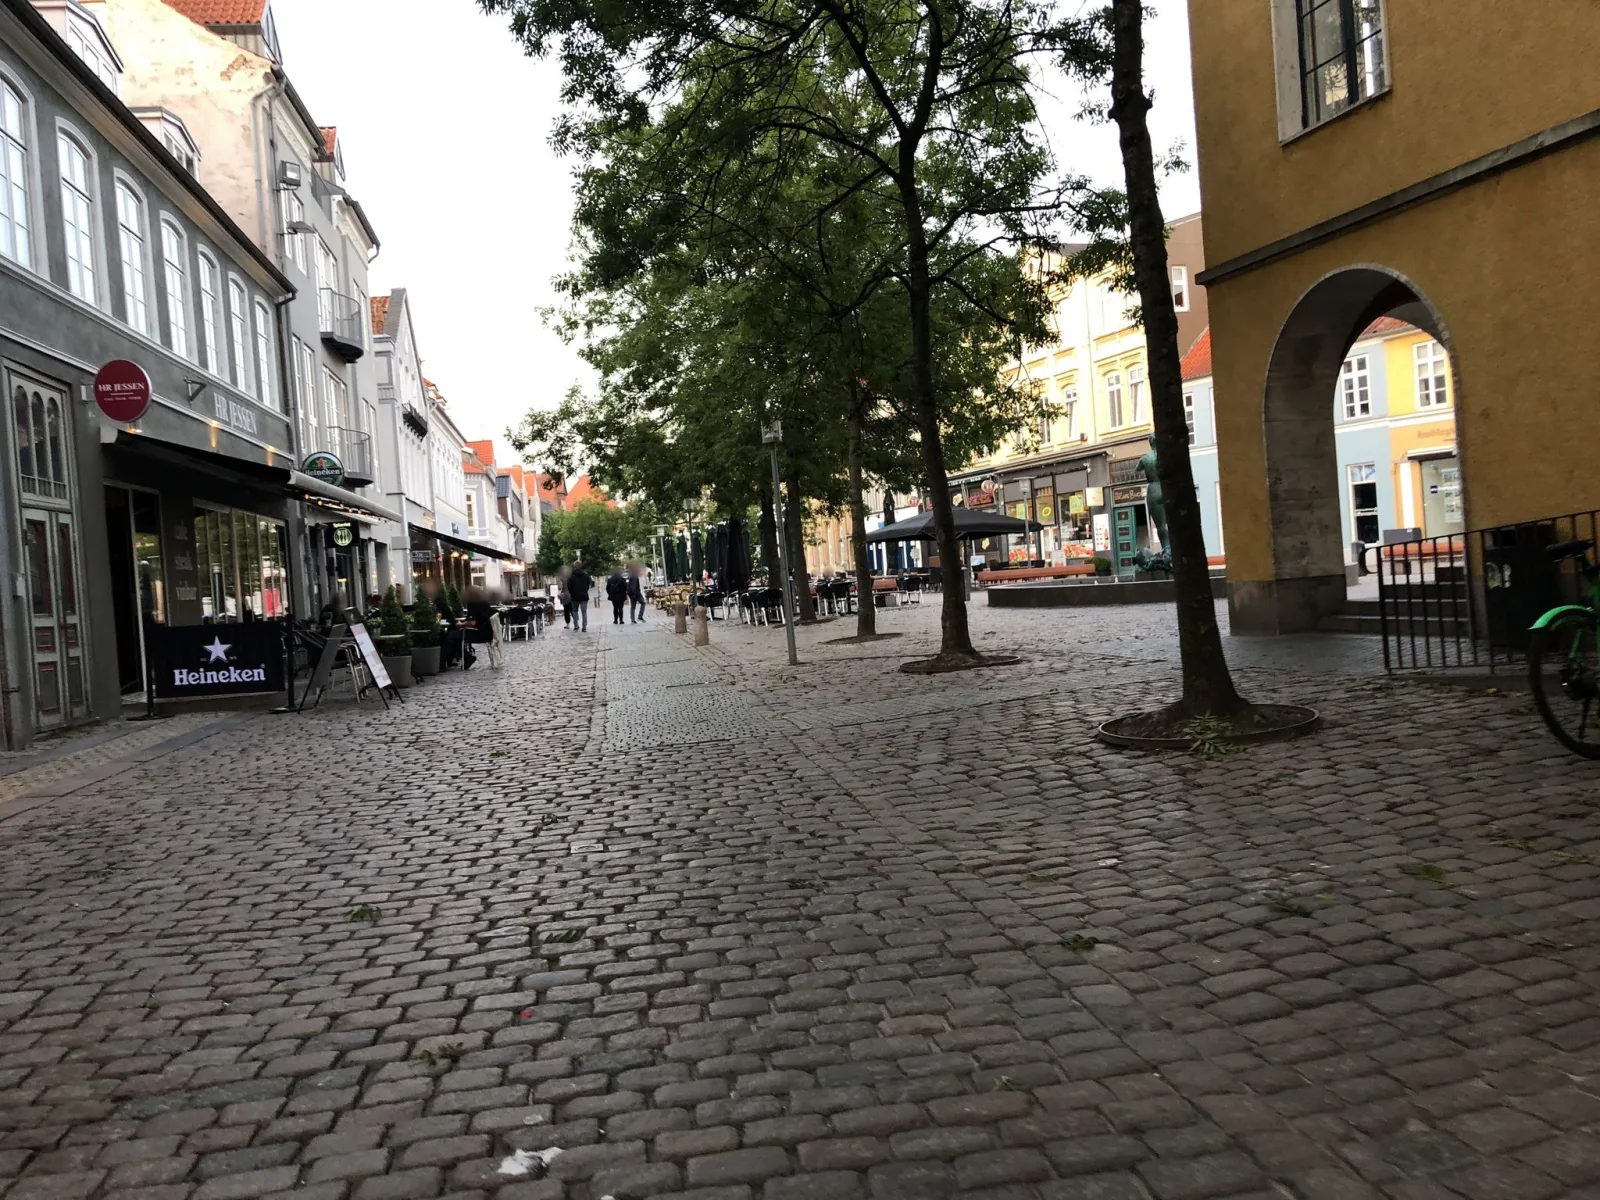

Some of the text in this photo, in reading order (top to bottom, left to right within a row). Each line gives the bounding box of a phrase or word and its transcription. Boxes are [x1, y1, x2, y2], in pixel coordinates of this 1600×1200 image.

[113, 382, 145, 392] JESSEN
[213, 392, 258, 434] HR JESSEN
[305, 468, 340, 476] Heineken
[173, 666, 266, 686] Heineken
